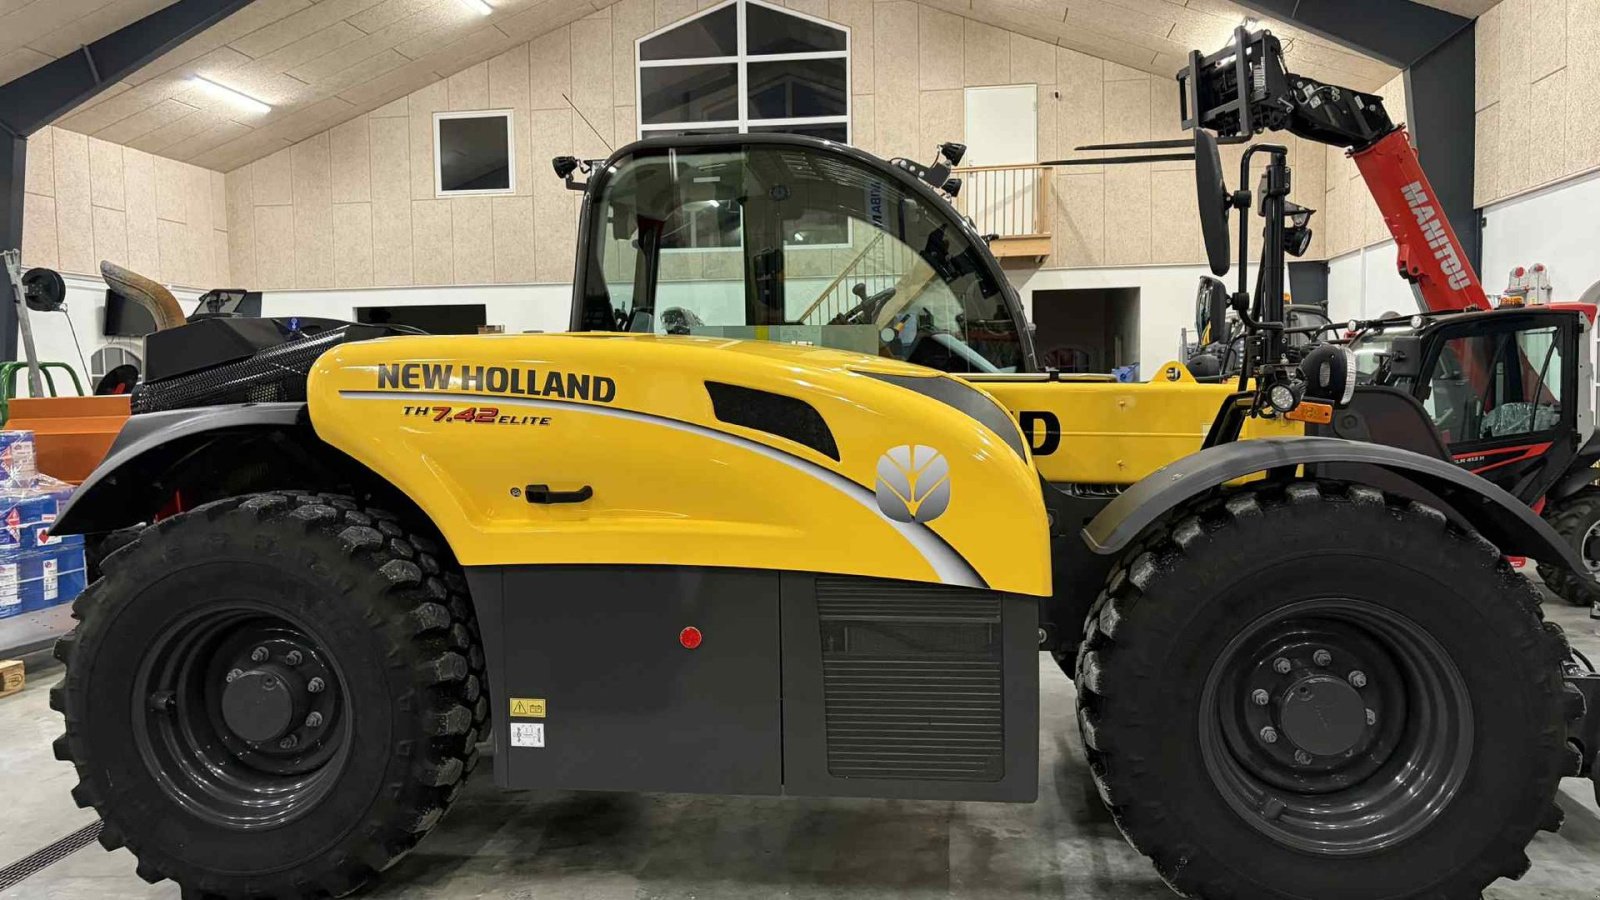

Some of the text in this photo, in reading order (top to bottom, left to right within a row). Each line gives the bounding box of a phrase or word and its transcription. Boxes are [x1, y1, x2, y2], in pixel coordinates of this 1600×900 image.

[1400, 181, 1471, 290] MANITOU
[378, 363, 616, 403] NEW HOLLAND
